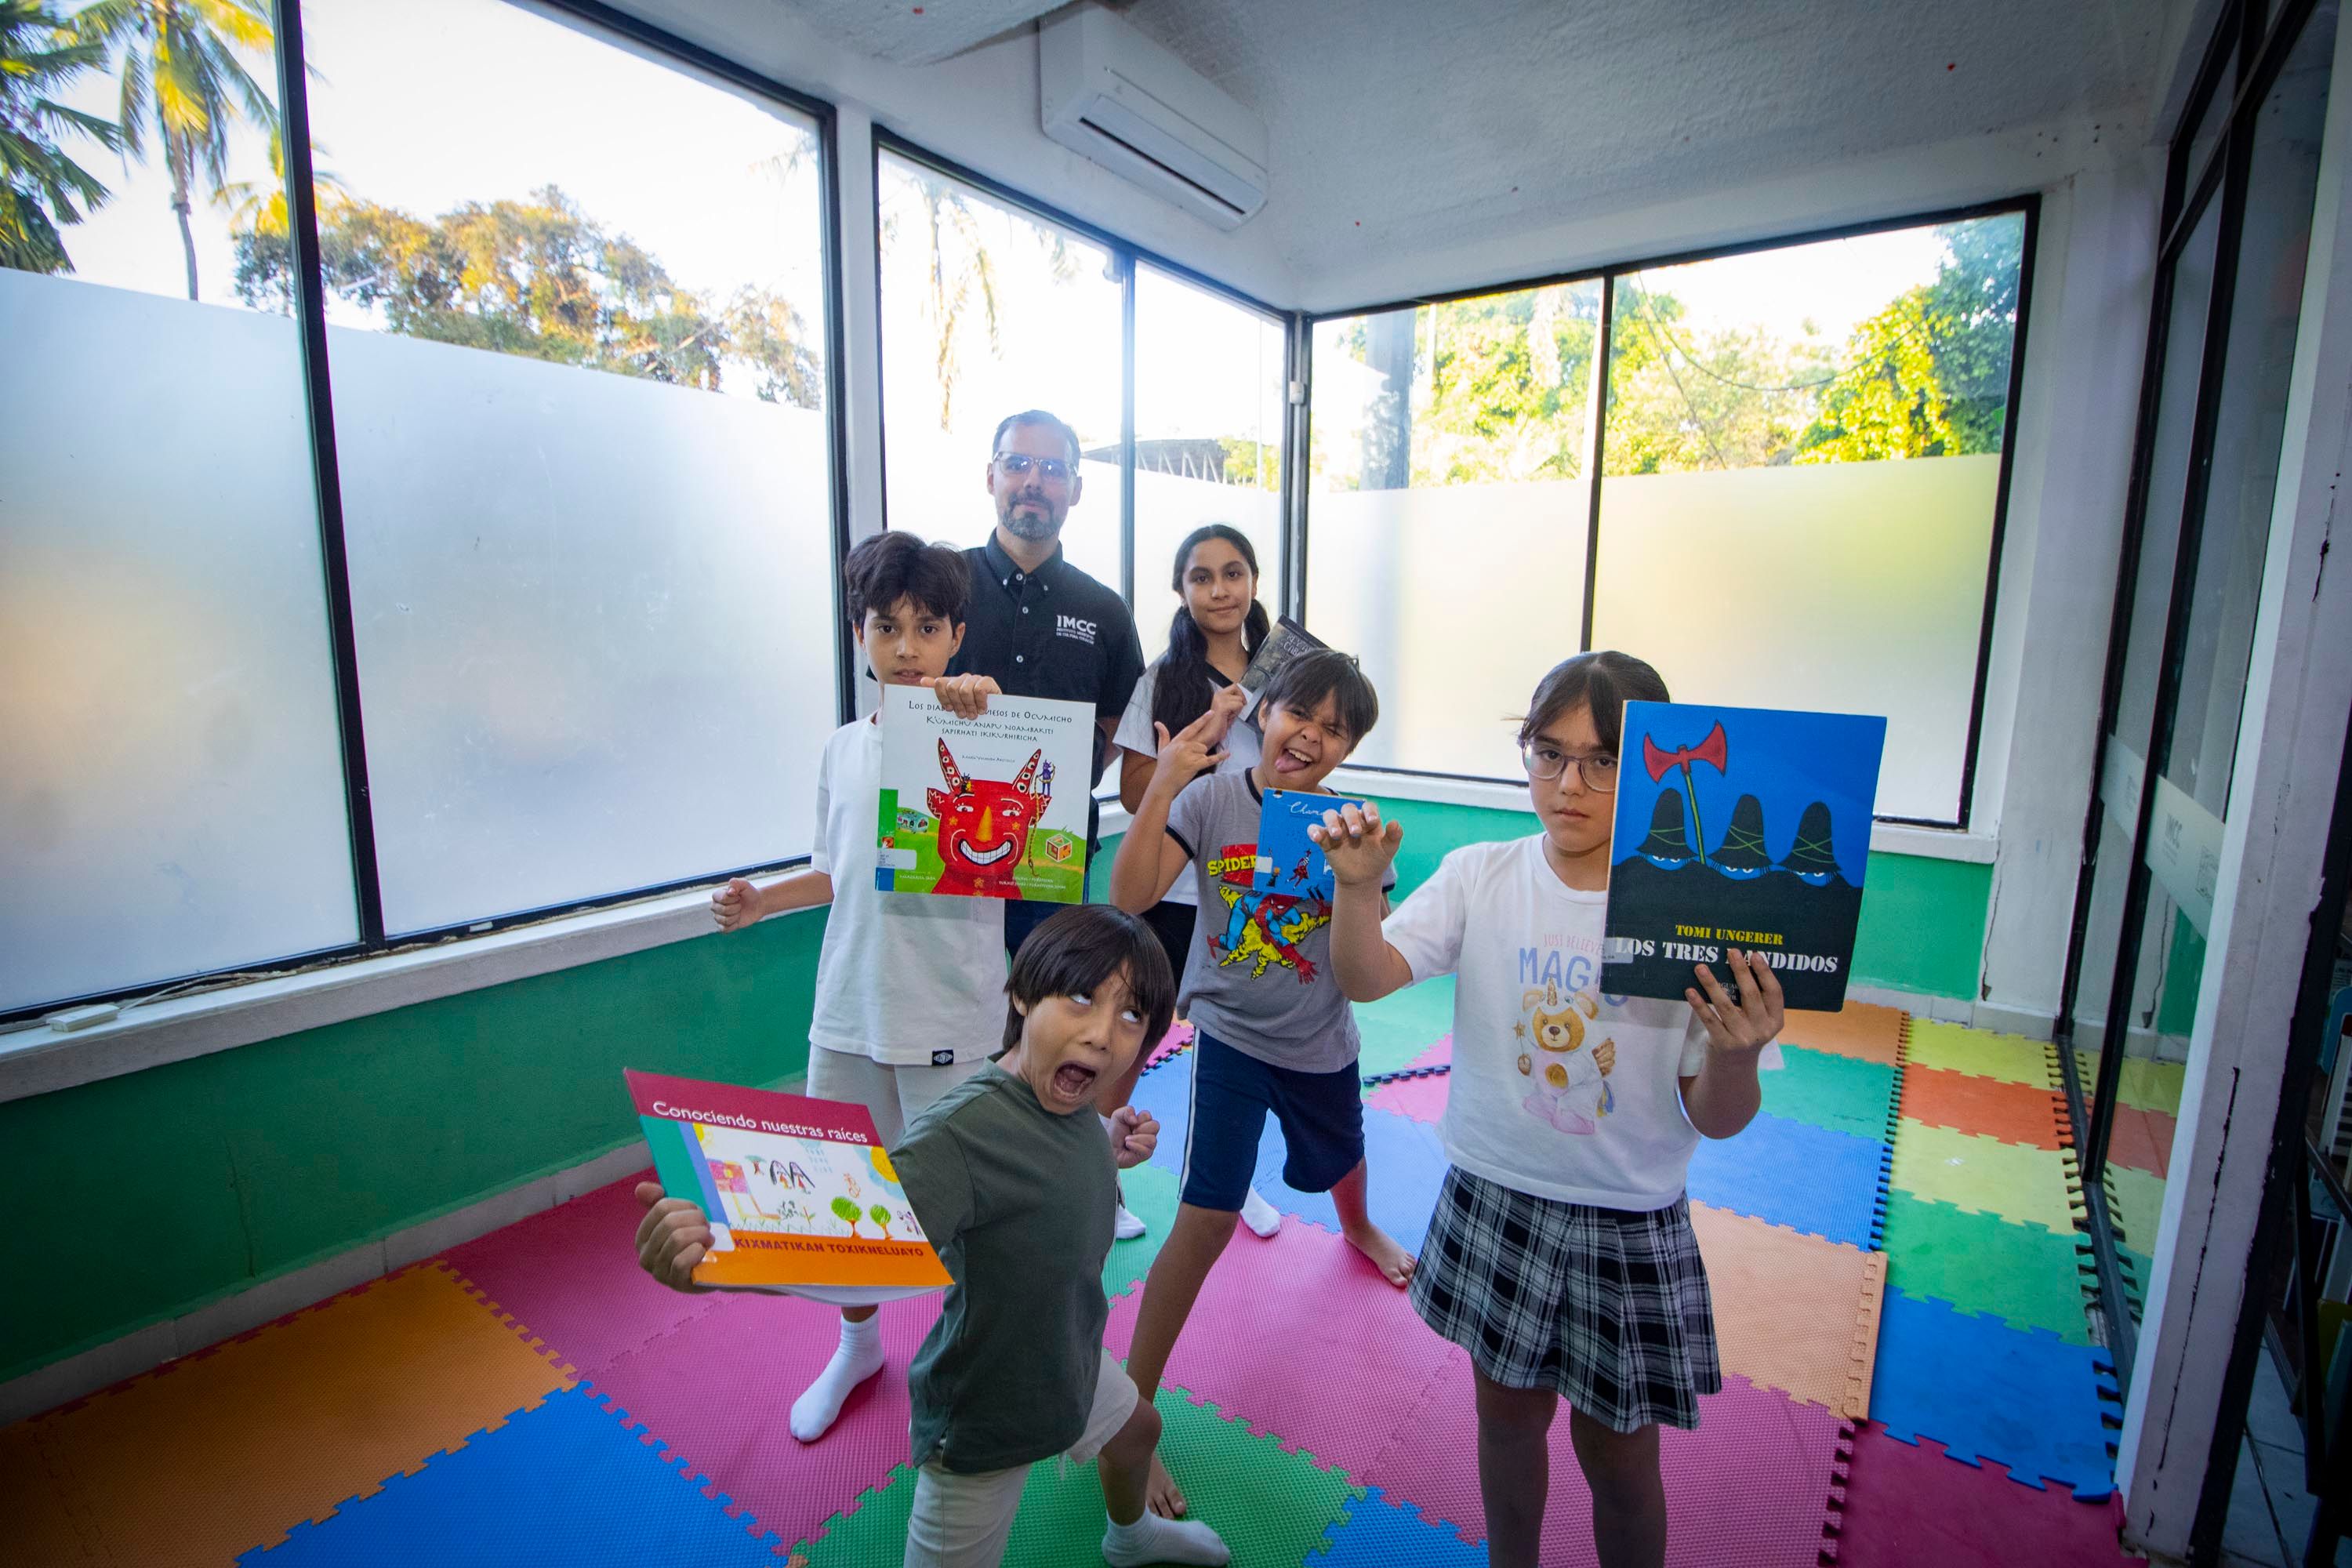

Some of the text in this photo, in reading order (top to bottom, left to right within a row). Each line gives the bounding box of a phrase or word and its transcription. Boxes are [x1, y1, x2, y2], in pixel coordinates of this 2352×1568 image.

[1057, 615, 1097, 635] IMCC
[1024, 711, 1073, 723] OCUMICHO
[1543, 934, 1563, 947] JUST
[1675, 924, 1784, 946] TOMI UNGERER
[1615, 938, 1655, 957] LOS
[1662, 941, 1719, 963] TRES
[1725, 948, 1838, 973] ANDIDOS
[1519, 947, 1601, 992] MAG
[653, 1100, 868, 1143] Conociendo nuestras raíces
[829, 1243, 924, 1257] TOXIKNELUAYO
